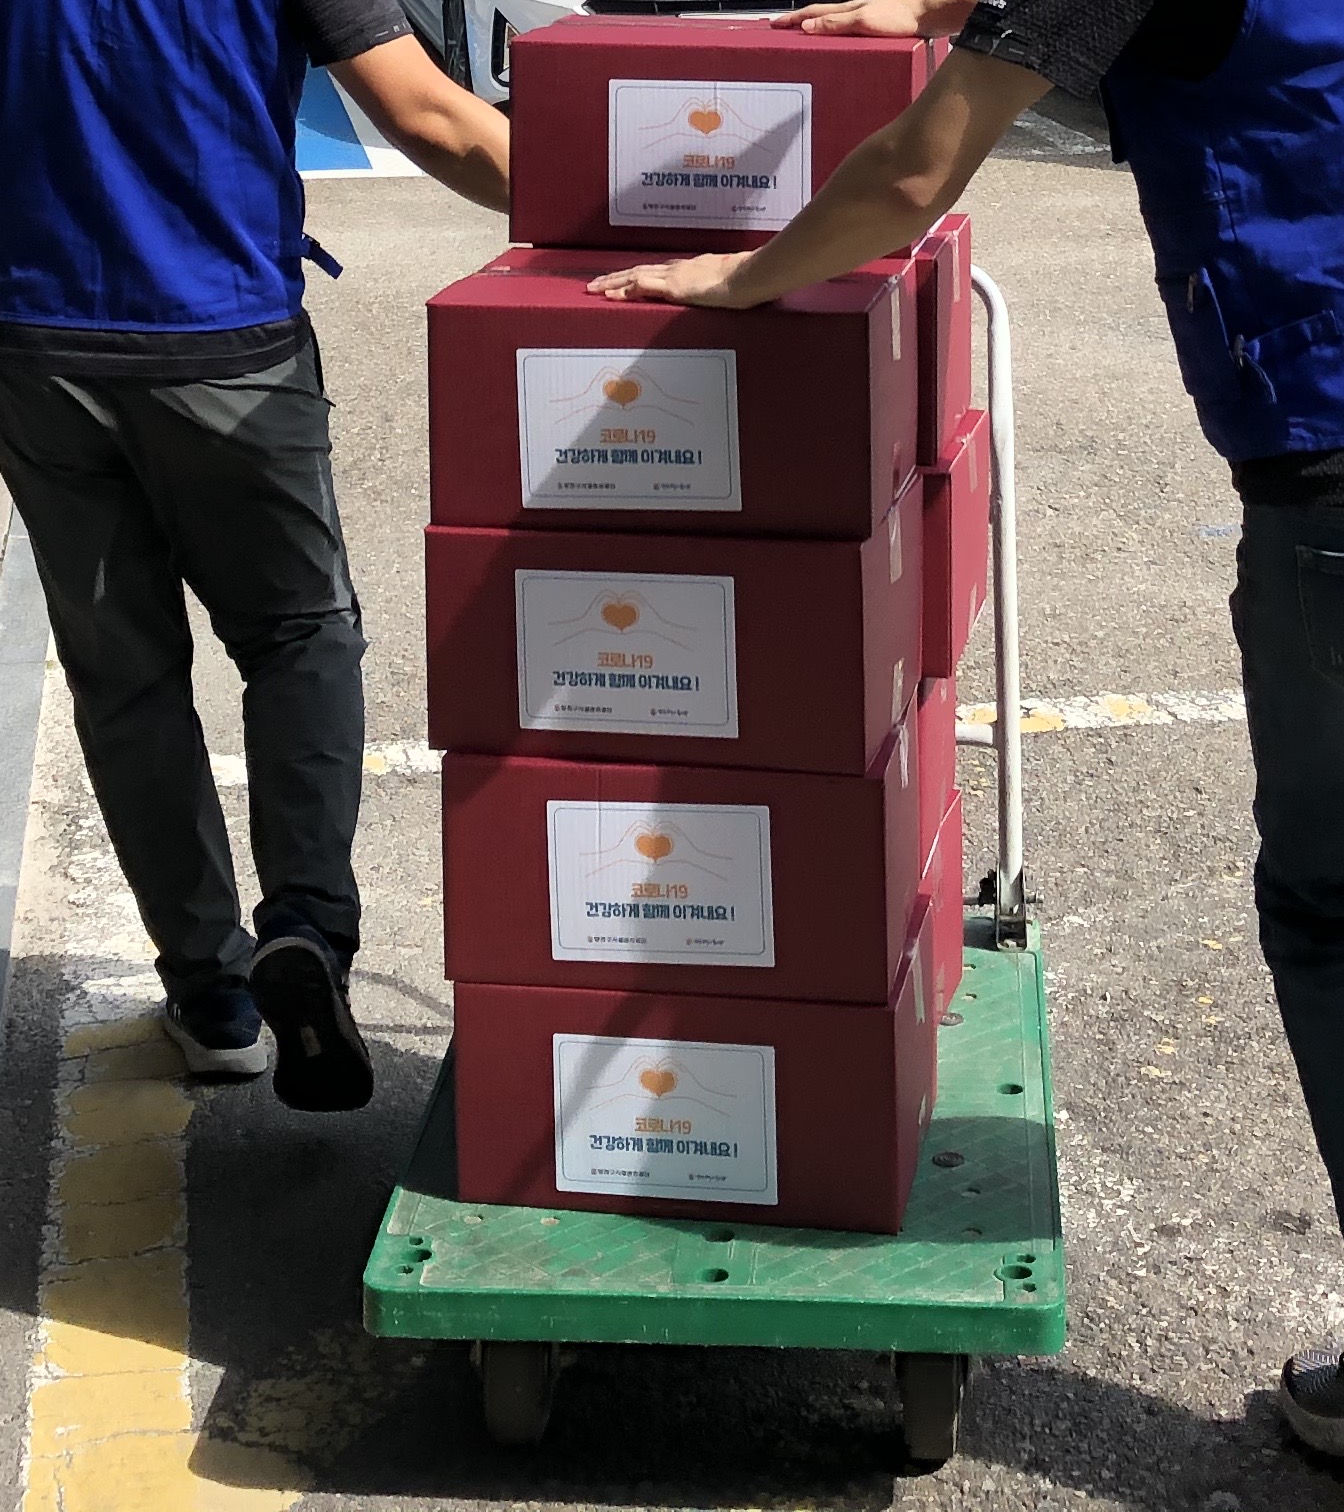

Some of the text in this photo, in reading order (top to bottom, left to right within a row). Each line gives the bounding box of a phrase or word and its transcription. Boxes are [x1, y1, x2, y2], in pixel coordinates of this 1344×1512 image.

[683, 154, 736, 170] 코로나19
[641, 172, 690, 188] 건강하게
[599, 428, 656, 445] 코로나19
[555, 448, 608, 464] 건강하게
[597, 651, 654, 669] 코로나19
[552, 670, 606, 688] 건강하게
[630, 882, 689, 899] 코로나19
[585, 901, 640, 919] 건강하게
[634, 1116, 692, 1135] 코로나19
[588, 1134, 643, 1153] 건강하게
